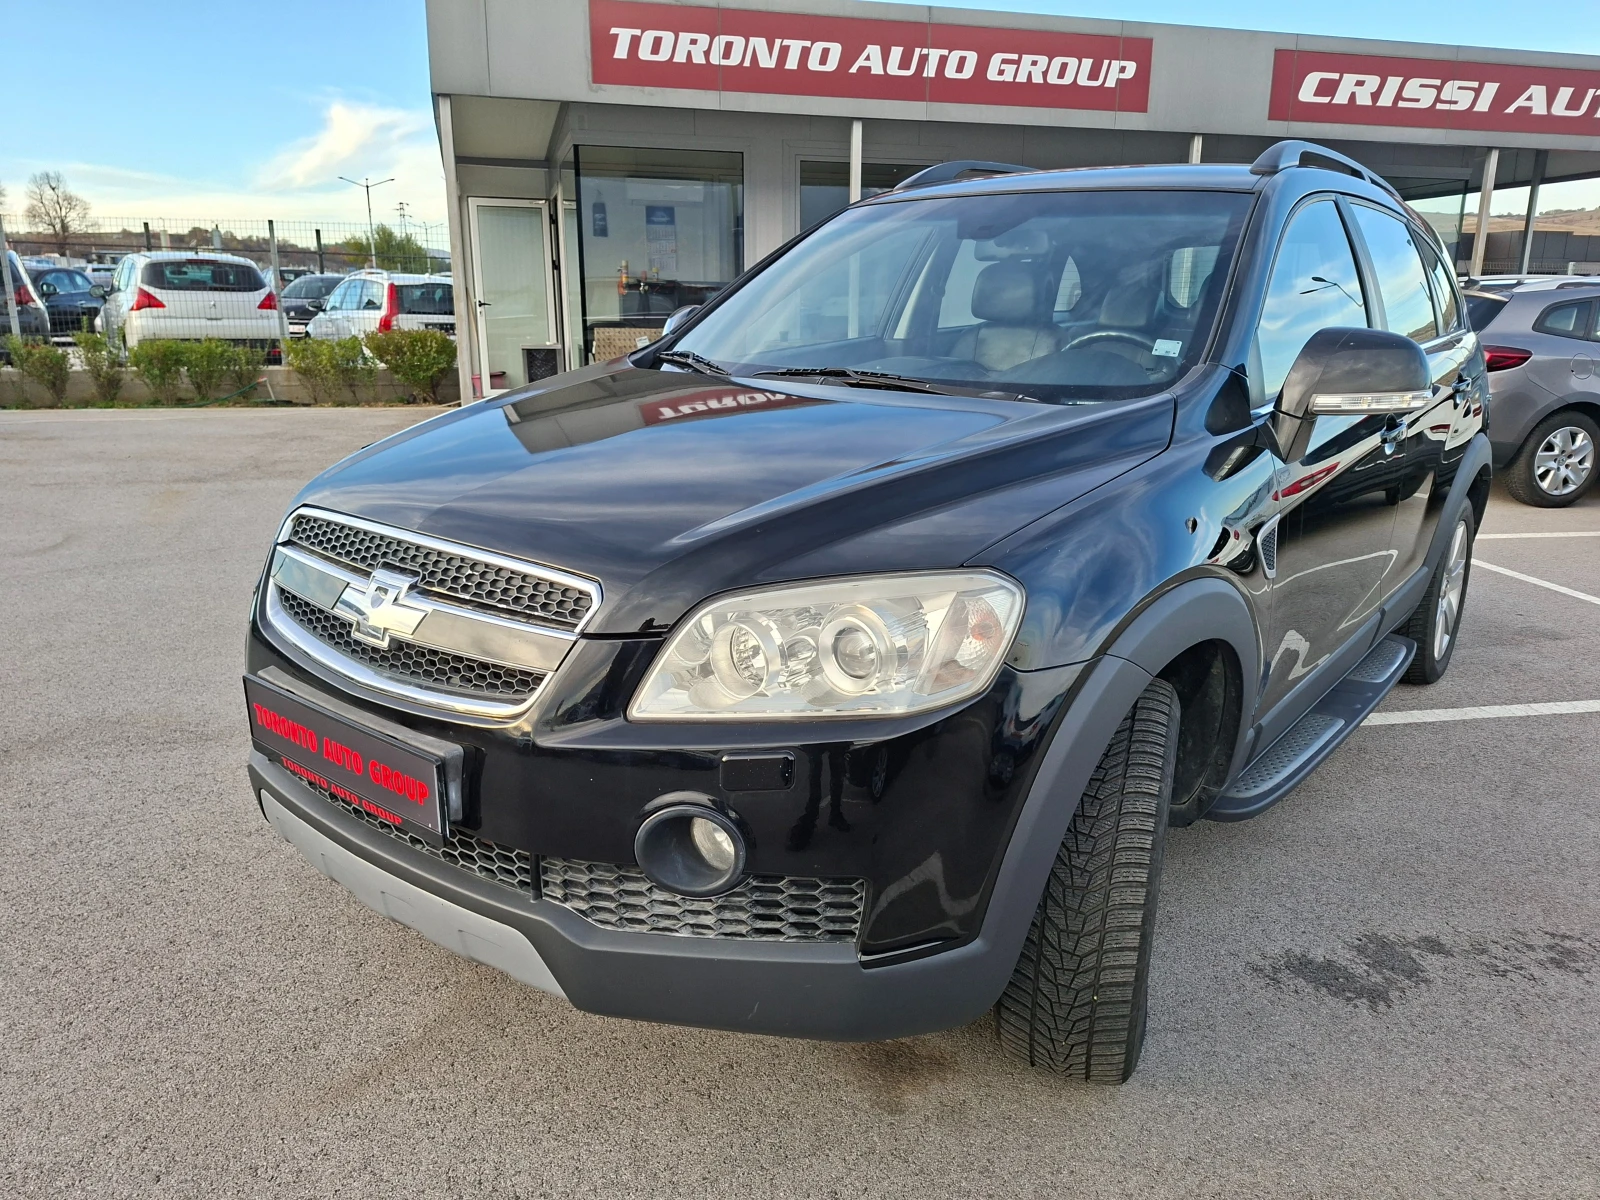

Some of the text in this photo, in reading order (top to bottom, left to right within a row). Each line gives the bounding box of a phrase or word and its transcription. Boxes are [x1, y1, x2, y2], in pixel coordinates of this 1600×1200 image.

[609, 27, 1137, 88] TORONTO AUTO GROUP
[1297, 71, 1600, 119] CRISSI AU
[253, 702, 430, 807] TORONTO AUTO GROUP
[281, 757, 403, 825] TORONTO AUTO GROUP
